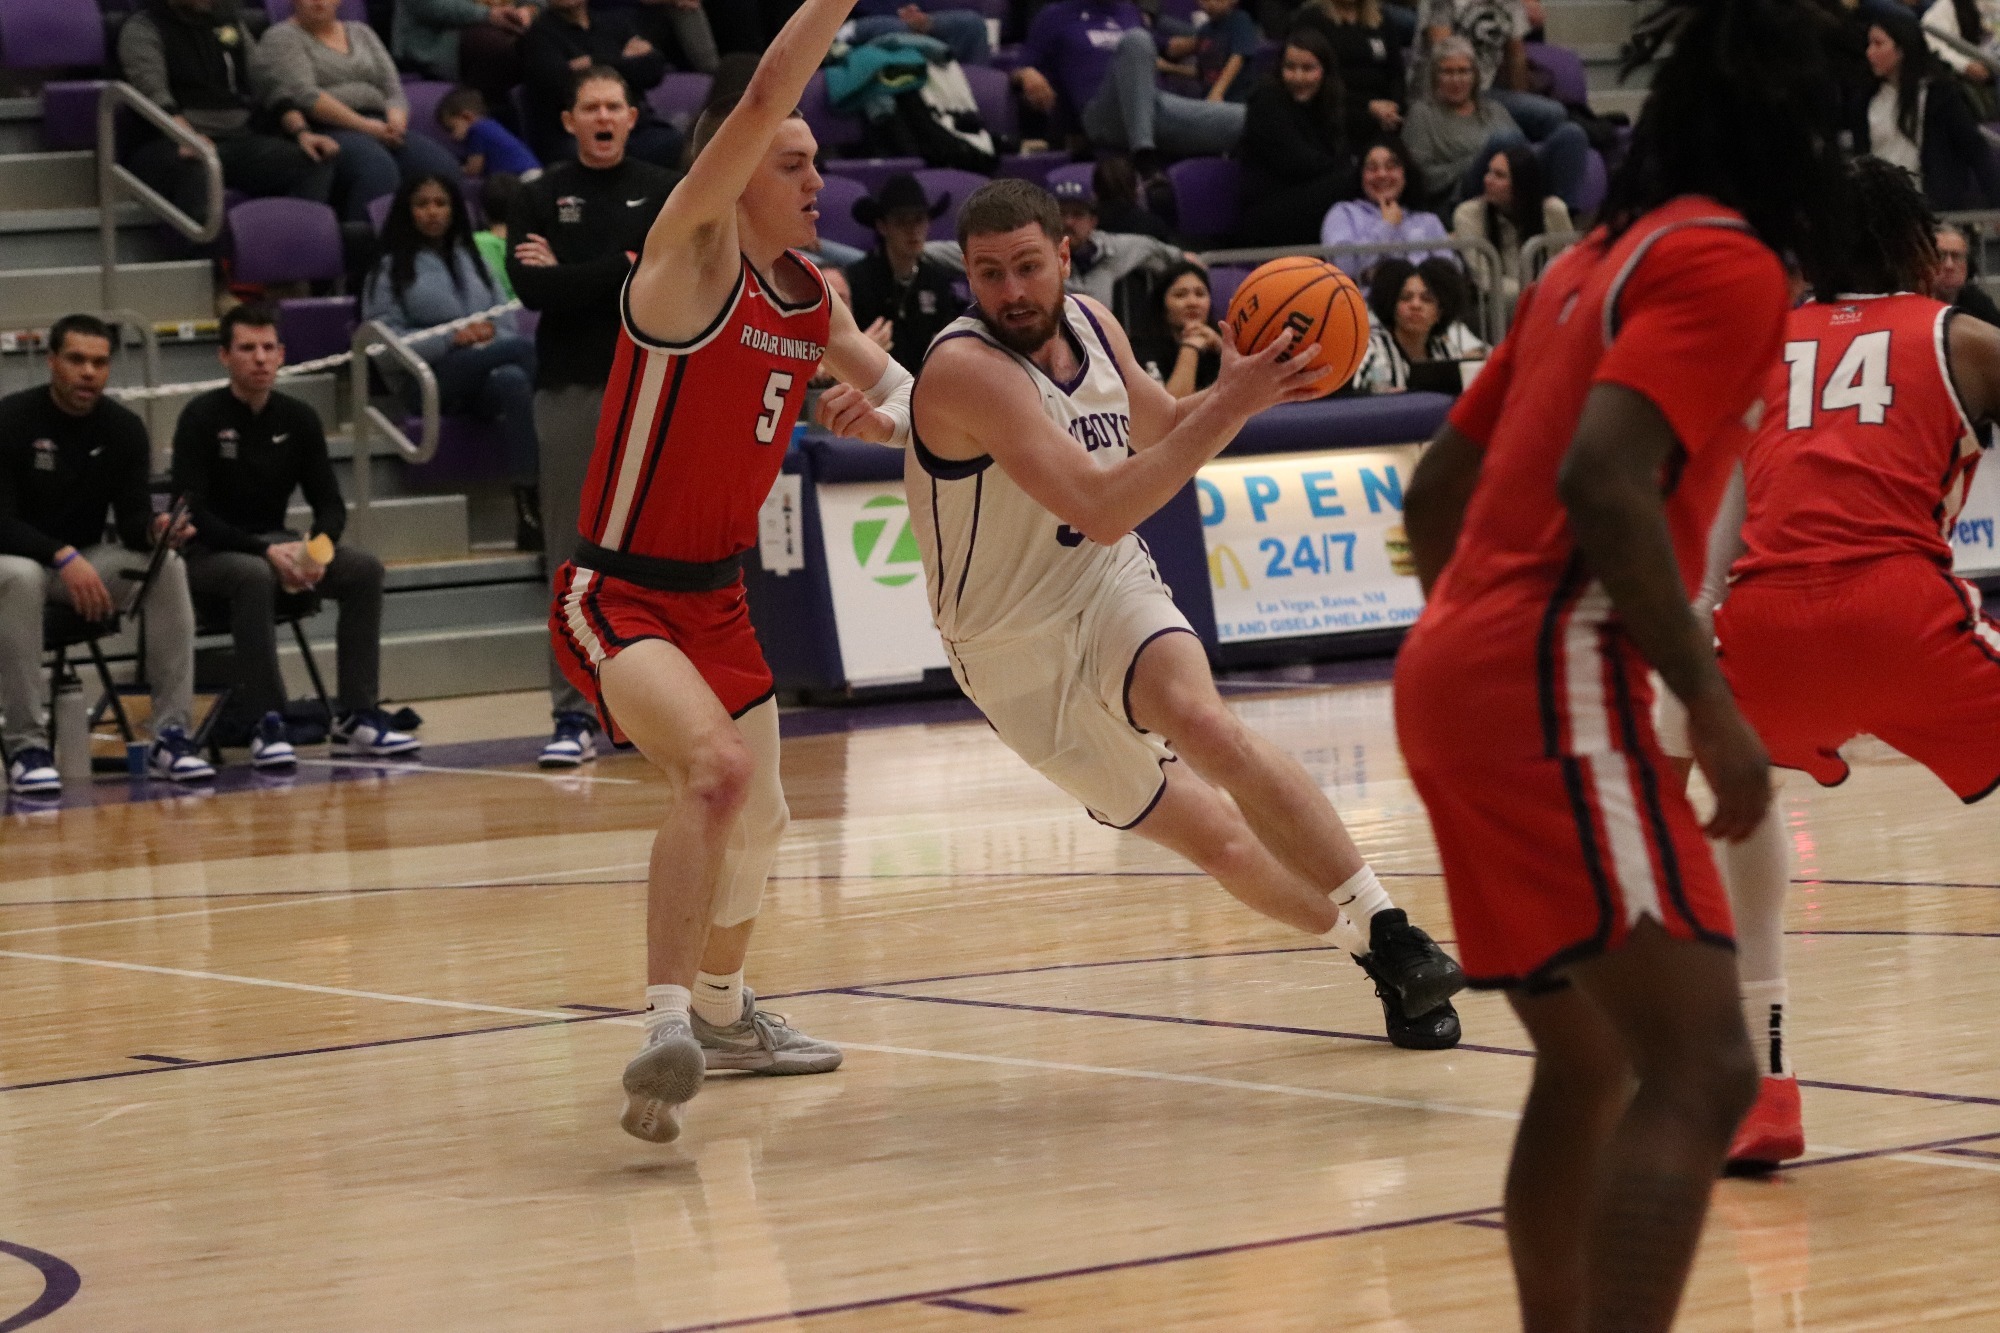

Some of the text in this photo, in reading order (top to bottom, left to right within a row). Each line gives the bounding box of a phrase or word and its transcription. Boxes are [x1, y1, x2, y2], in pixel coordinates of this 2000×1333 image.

[755, 370, 793, 443] 5
[1784, 330, 1894, 430] 14
[1195, 465, 1403, 527] OPEN
[1259, 532, 1357, 578] 24/7
[1238, 620, 1267, 635] AND
[1256, 601, 1278, 615] Las
